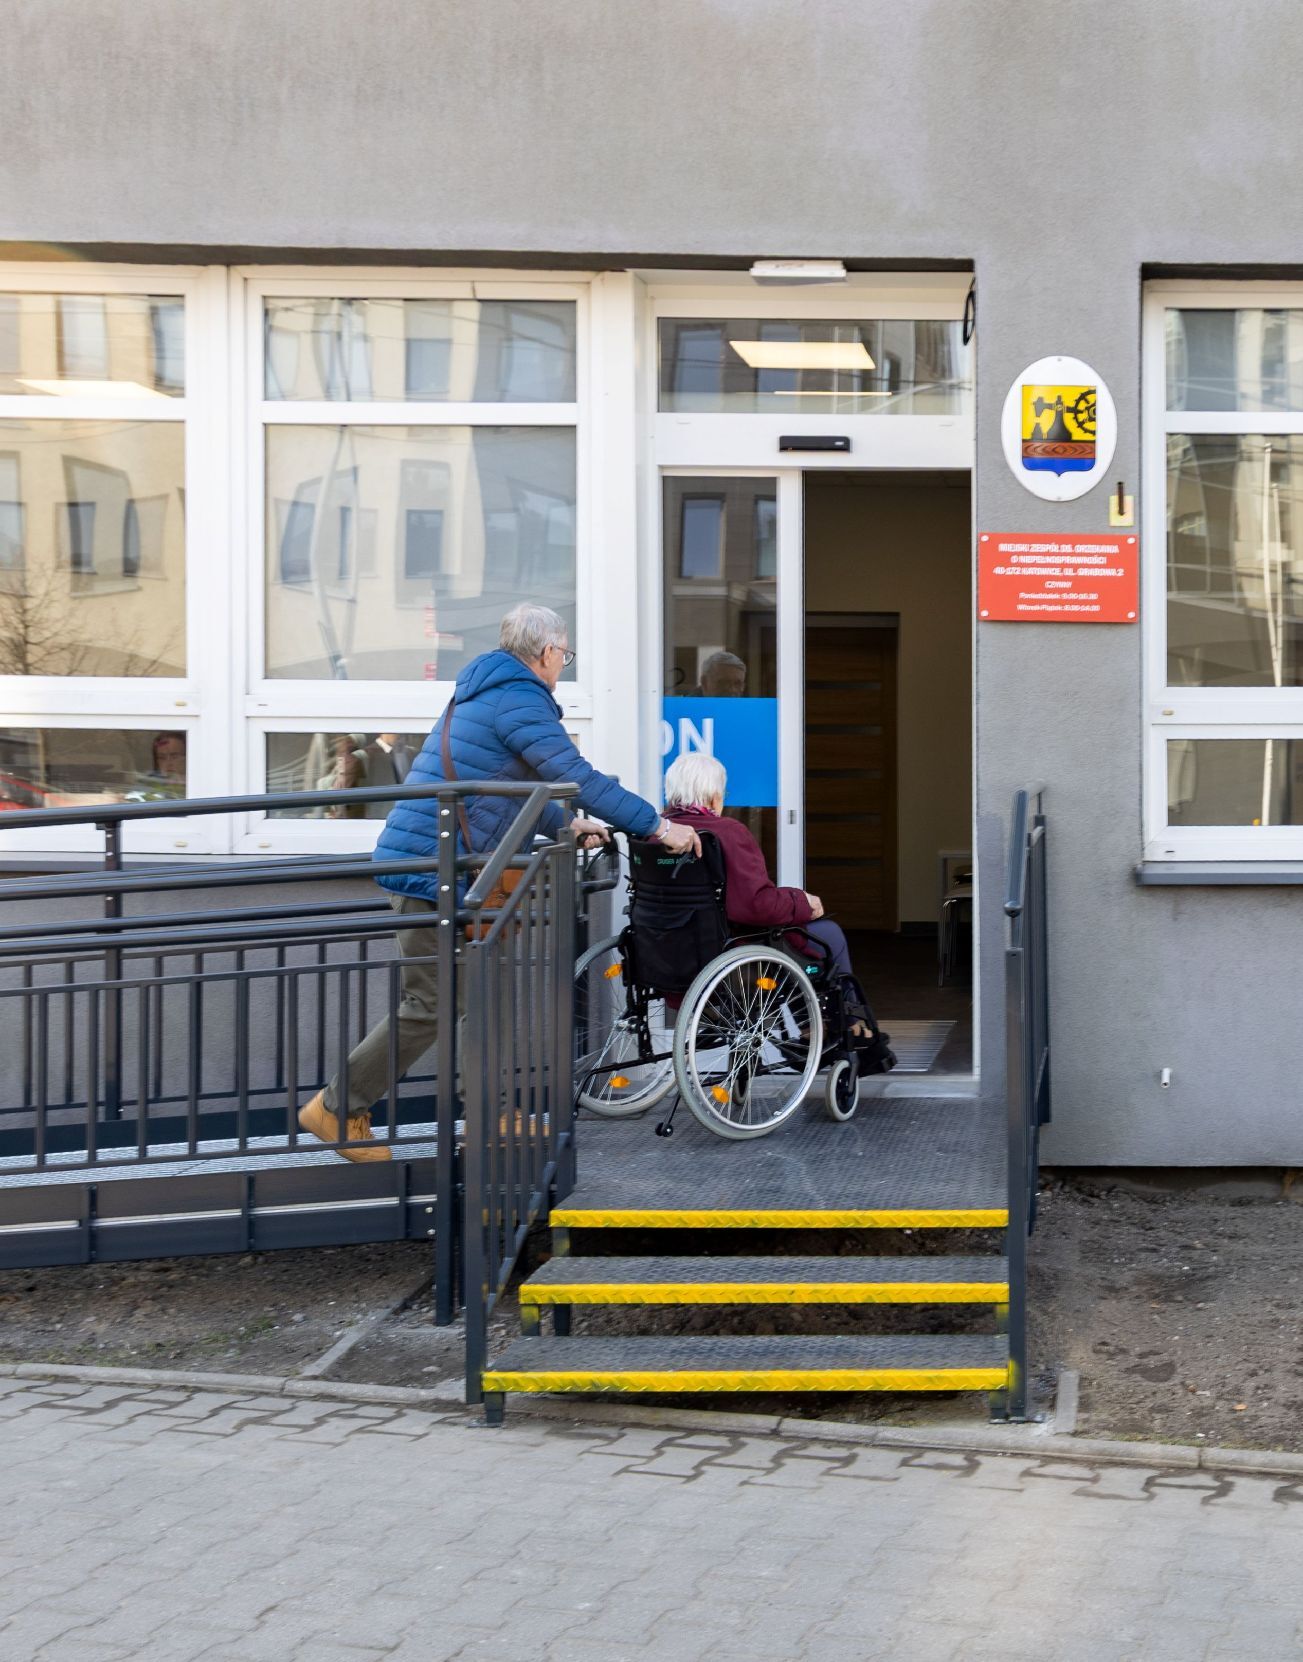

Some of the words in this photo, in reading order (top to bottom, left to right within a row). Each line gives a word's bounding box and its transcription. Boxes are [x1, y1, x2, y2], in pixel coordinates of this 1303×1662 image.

[998, 543, 1029, 552] MIEJSKI
[1074, 544, 1119, 554] ORZEKANIA
[1011, 555, 1019, 563] O
[1019, 554, 1107, 565] NIEPEŁNOSPRAWNOŚCI
[1044, 581, 1073, 589] CZYNNY
